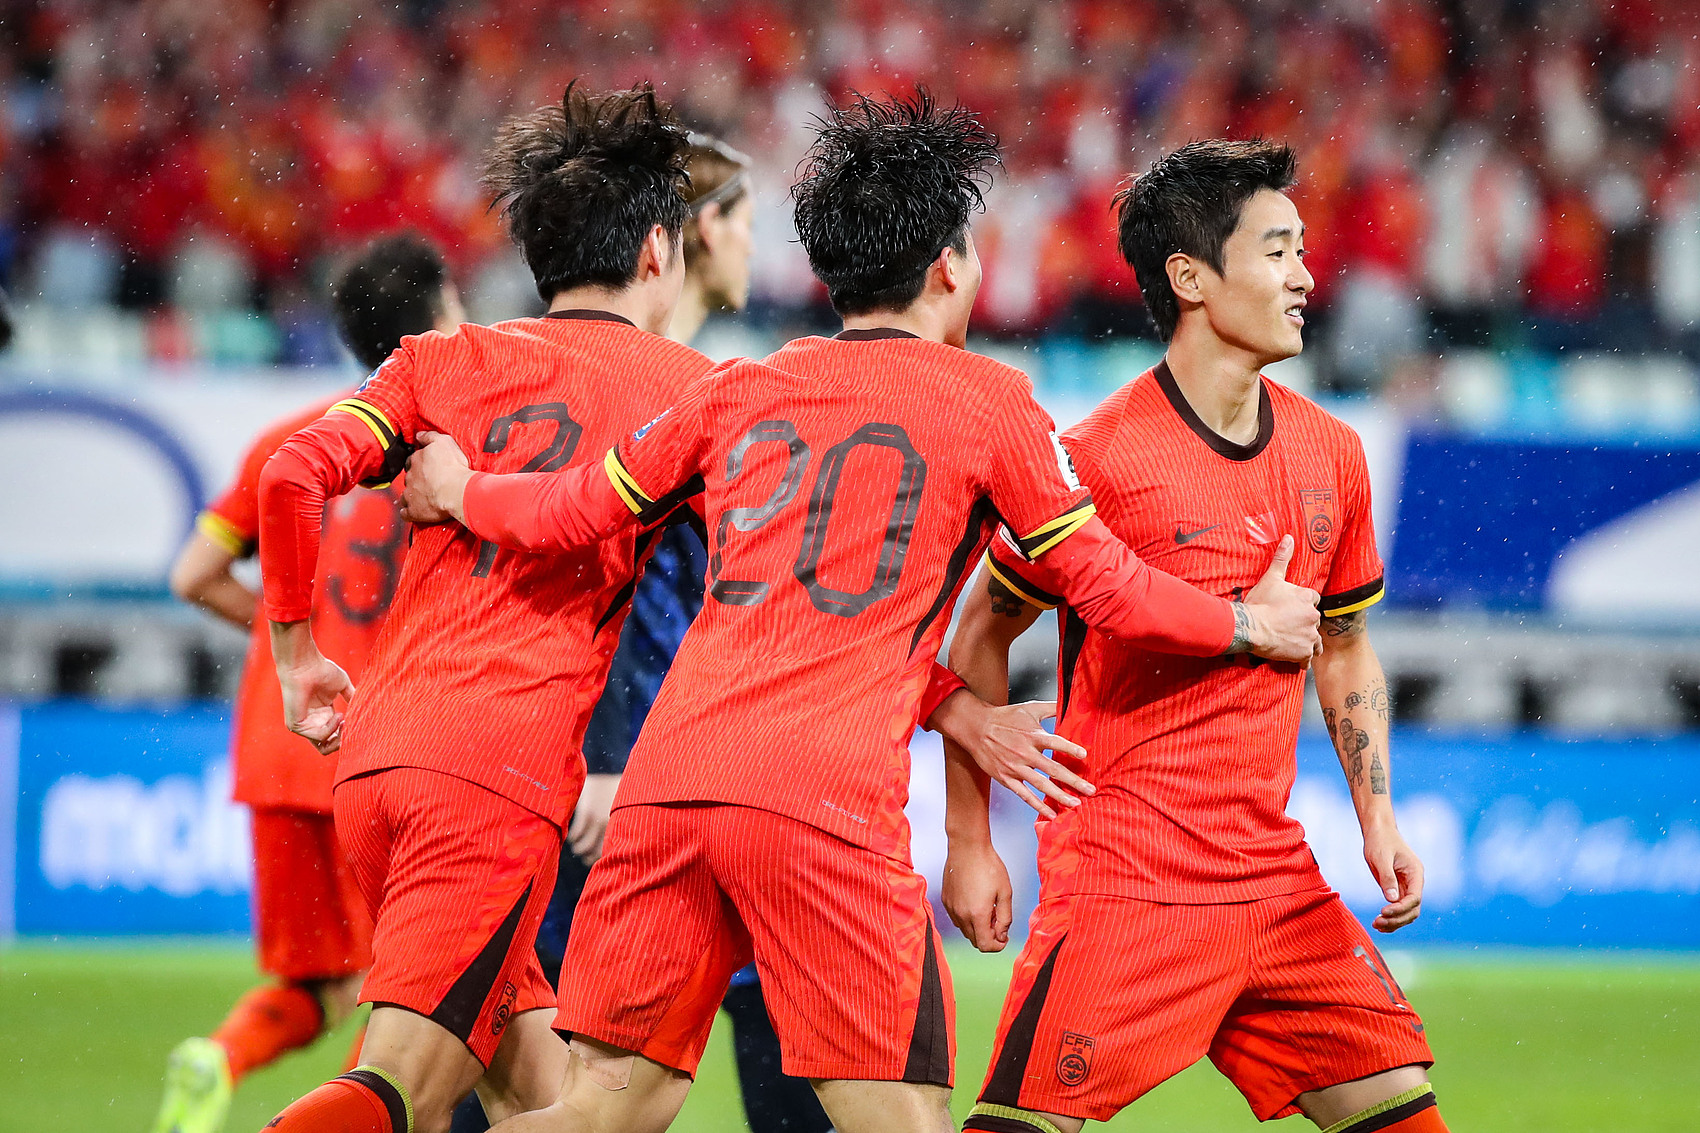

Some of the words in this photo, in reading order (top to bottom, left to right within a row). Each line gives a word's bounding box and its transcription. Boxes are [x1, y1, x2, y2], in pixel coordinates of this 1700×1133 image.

[1304, 492, 1332, 505] CFA
[710, 420, 928, 618] 20
[1065, 1035, 1093, 1050] CFA
